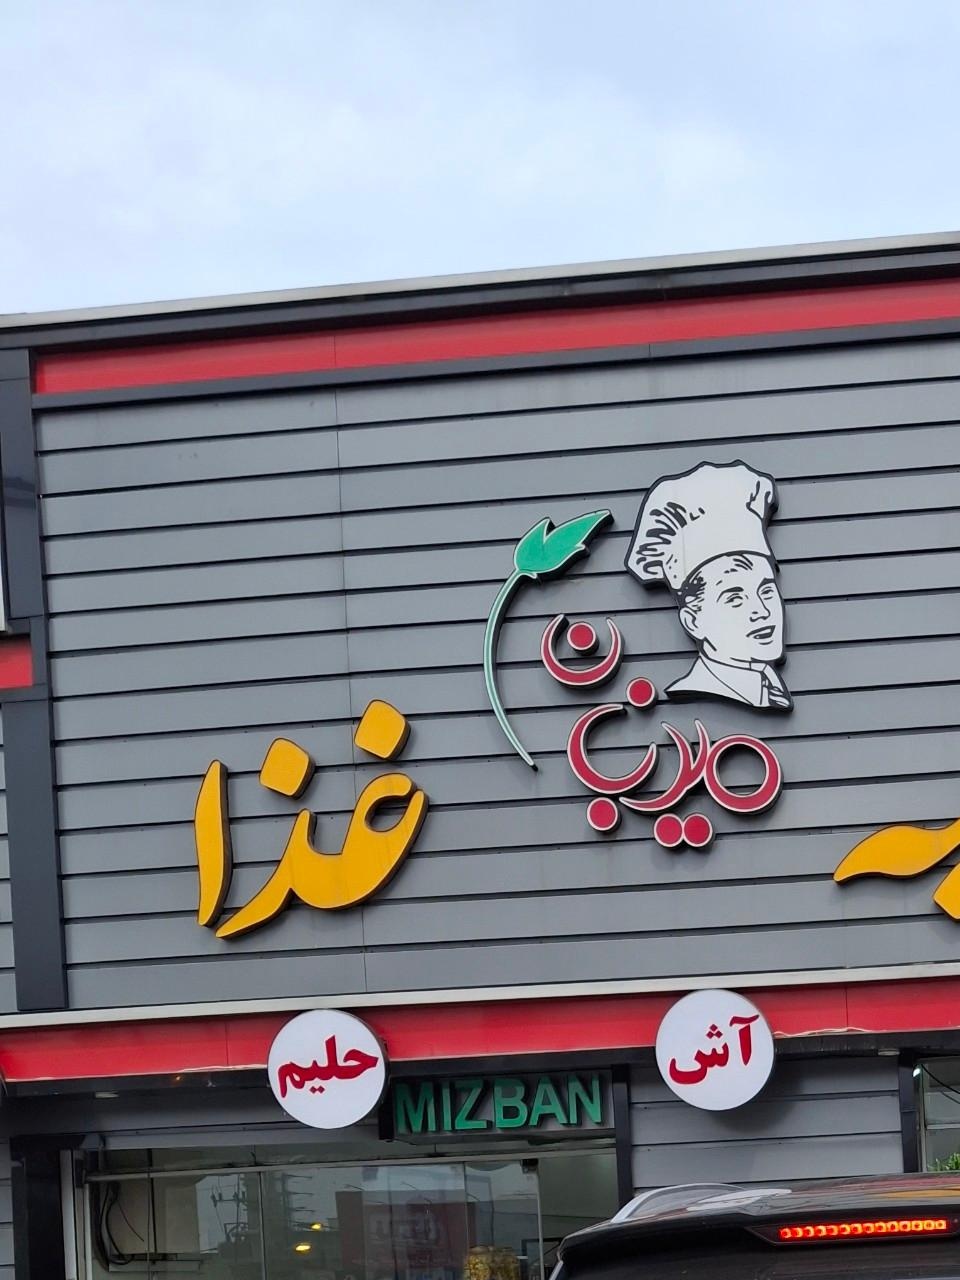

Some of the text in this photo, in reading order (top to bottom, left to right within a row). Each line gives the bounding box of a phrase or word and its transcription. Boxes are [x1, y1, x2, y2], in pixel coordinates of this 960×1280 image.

[195, 699, 429, 939] غذا
[277, 1035, 380, 1098] حلیم
[667, 1014, 760, 1086] آش
[396, 1074, 602, 1133] MIZBAN
